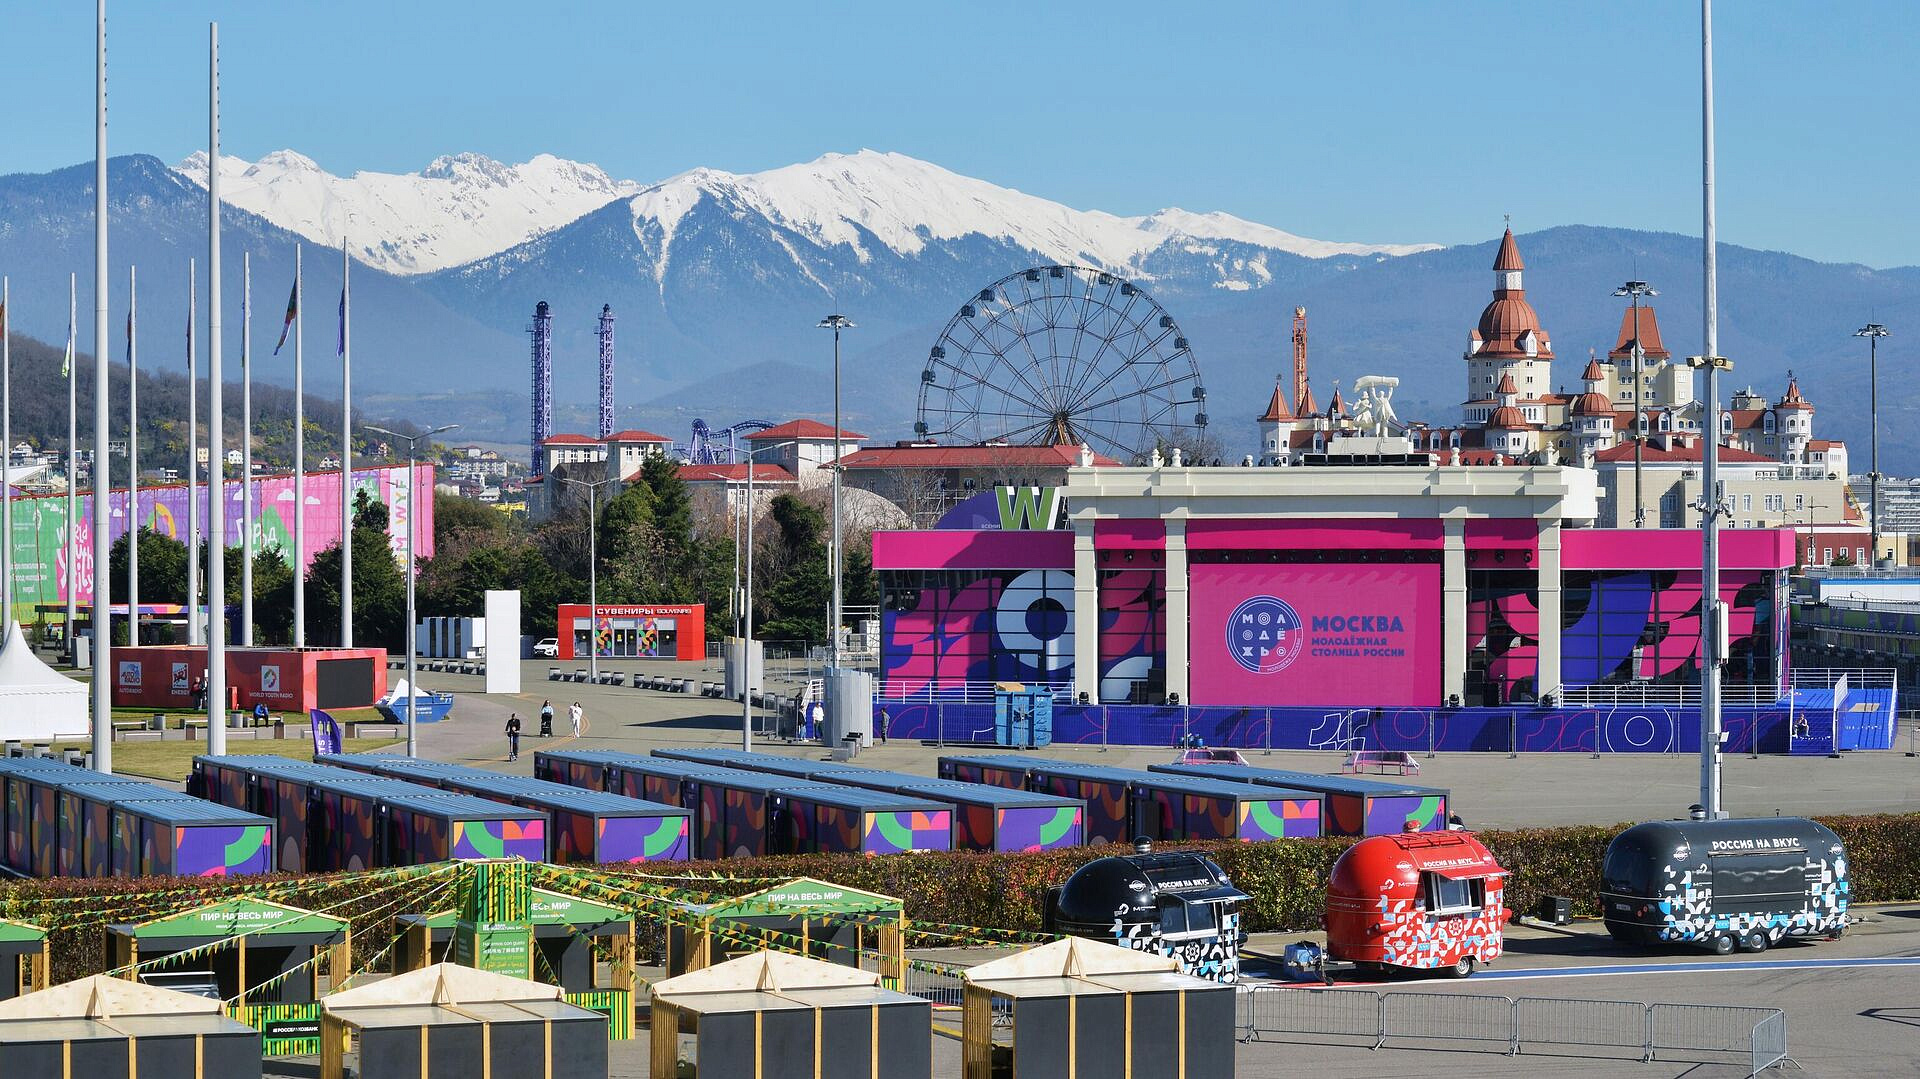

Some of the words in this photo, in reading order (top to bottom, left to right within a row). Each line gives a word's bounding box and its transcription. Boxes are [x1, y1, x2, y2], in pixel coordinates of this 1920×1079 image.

[995, 486, 1058, 530] W
[1311, 615, 1405, 633] МОСКВА
[1311, 635, 1388, 645] МОЛОДЁЖНАЯ
[1311, 648, 1360, 657] СТОЛИЦА
[1363, 648, 1405, 657] РОССИИ
[1712, 839, 1754, 850] РОССИЯ
[1756, 838, 1771, 849] НА
[1772, 837, 1800, 848] ВКУС
[1423, 859, 1448, 868] РОССИЯ
[1448, 858, 1458, 866] НА
[1458, 857, 1473, 865] ВКУС
[1158, 880, 1183, 889] РОССИЯ
[1183, 879, 1193, 887] НА
[1193, 878, 1210, 886] ВКУС
[801, 892, 823, 901] ВЕСЬ
[824, 892, 843, 900] МИР
[551, 902, 571, 910] МИР
[200, 912, 220, 921] ПИР
[222, 912, 236, 921] НА
[237, 911, 261, 920] ВЕСЬ
[262, 911, 283, 919] МИР
